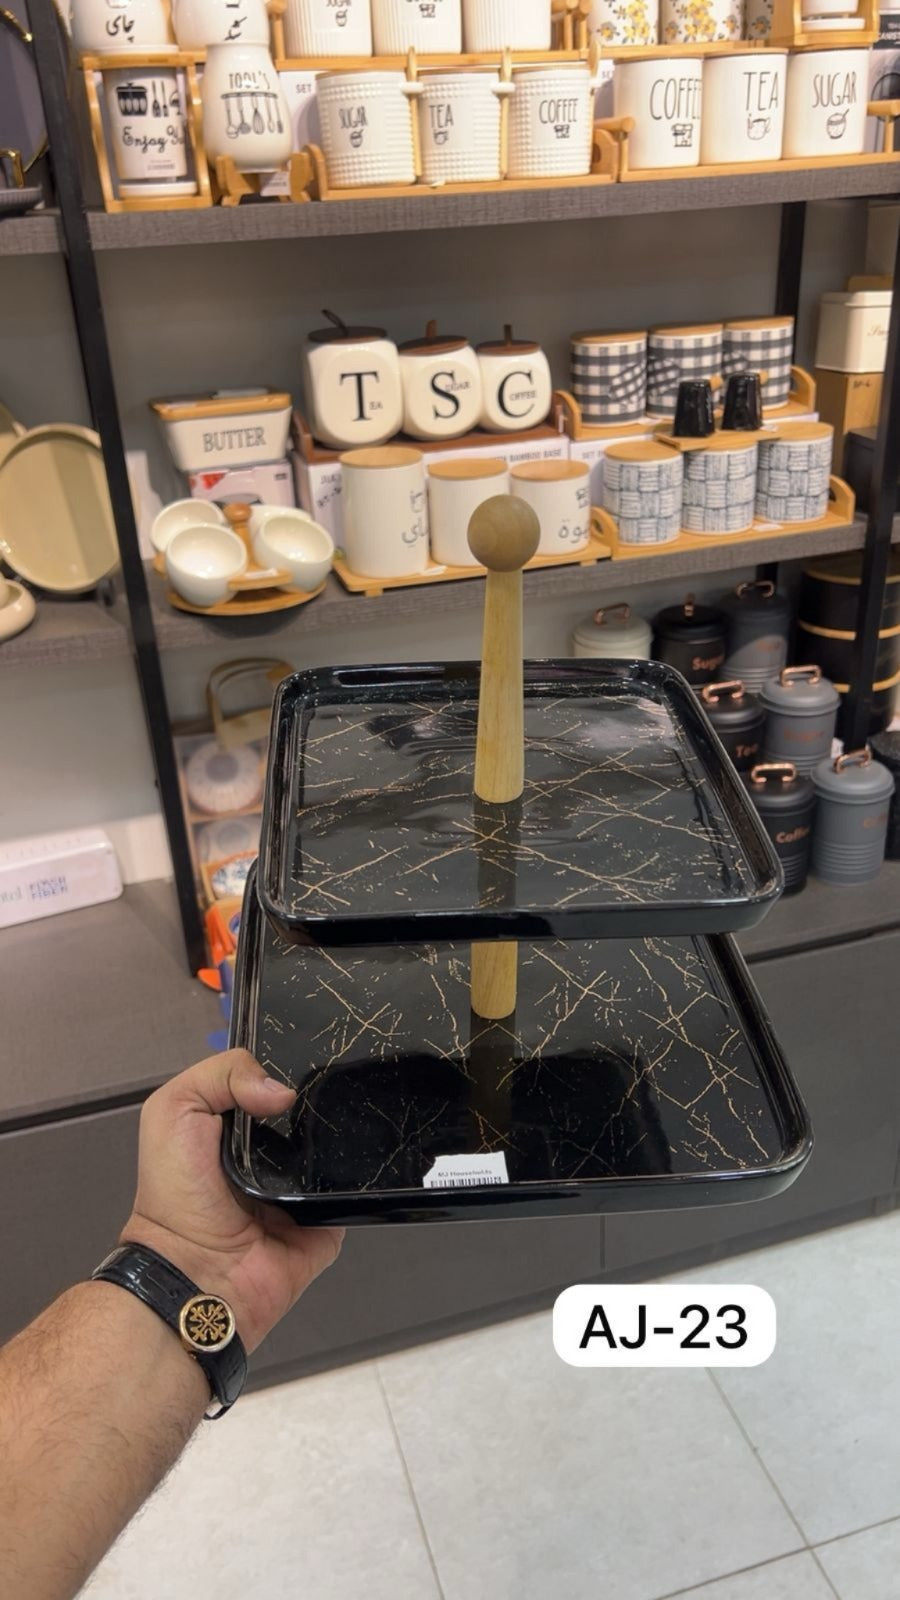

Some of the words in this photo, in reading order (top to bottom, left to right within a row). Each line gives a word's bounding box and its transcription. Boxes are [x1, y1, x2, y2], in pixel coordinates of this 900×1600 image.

[106, 14, 135, 43] چای
[743, 71, 779, 112] TEA
[812, 70, 857, 109] SUGAR
[339, 106, 368, 130] SUGAR
[428, 104, 454, 128] TEA
[538, 98, 579, 125] COFFEE
[122, 126, 167, 154] Enjoy
[202, 426, 267, 454] BUTTER
[543, 447, 562, 458] BASE
